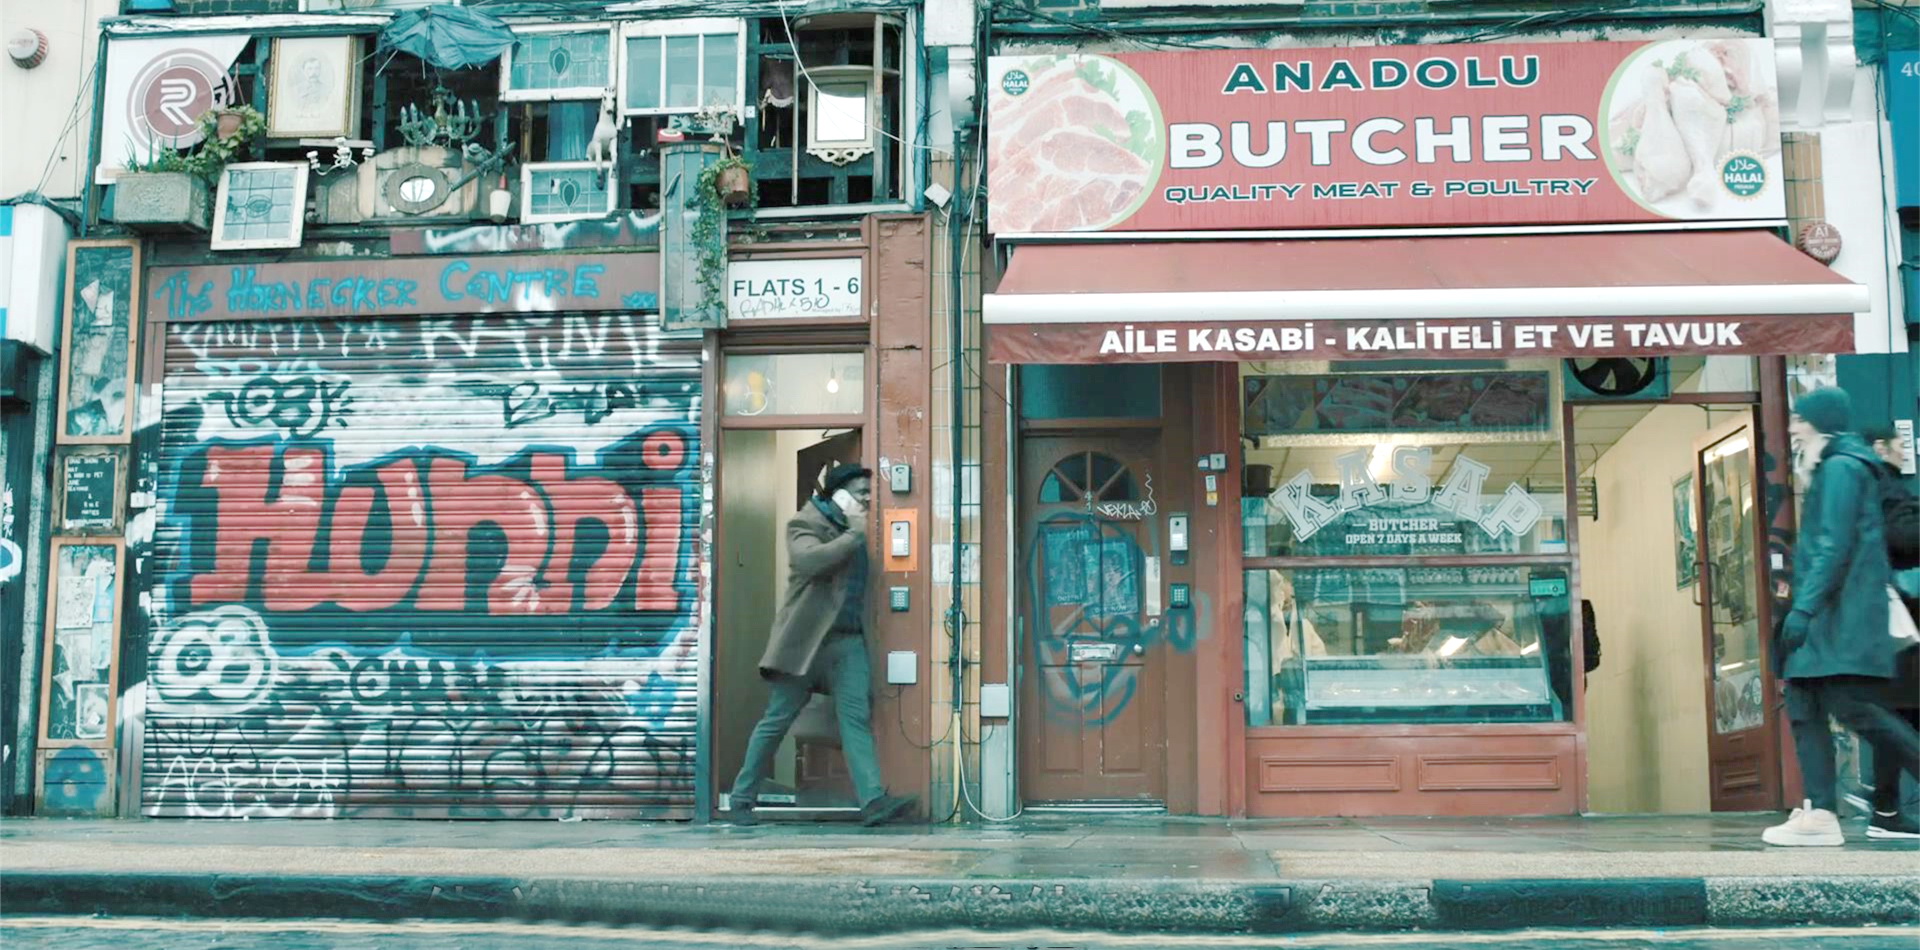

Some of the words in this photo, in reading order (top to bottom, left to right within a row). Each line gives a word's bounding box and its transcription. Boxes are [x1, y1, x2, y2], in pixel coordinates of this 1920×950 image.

[1003, 80, 1028, 88] HALAL
[1223, 56, 1539, 94] ANADOLU
[1168, 114, 1598, 168] BUTCHER
[1725, 172, 1764, 183] HALAL
[1165, 183, 1306, 203] QUALITY
[1312, 181, 1399, 199] MEAT
[1409, 182, 1436, 197] &
[1445, 178, 1599, 196] POULTRY
[734, 278, 805, 297] FLATS
[814, 278, 823, 295] 1
[847, 277, 860, 295] 6
[1100, 325, 1177, 353] AİLE
[1188, 322, 1314, 352] KASABİ
[1346, 320, 1501, 351] KALİTELİ
[1514, 325, 1558, 349] ET
[1567, 323, 1613, 348] VE
[1623, 322, 1743, 347] TAVUK
[1268, 445, 1544, 543] KASAP
[1369, 518, 1439, 531] BUTCHER
[1345, 533, 1375, 544] OPEN
[1377, 533, 1385, 544] 7
[1386, 533, 1416, 544] DAYS
[1418, 533, 1427, 544] A
[1428, 533, 1463, 543] WEEK
